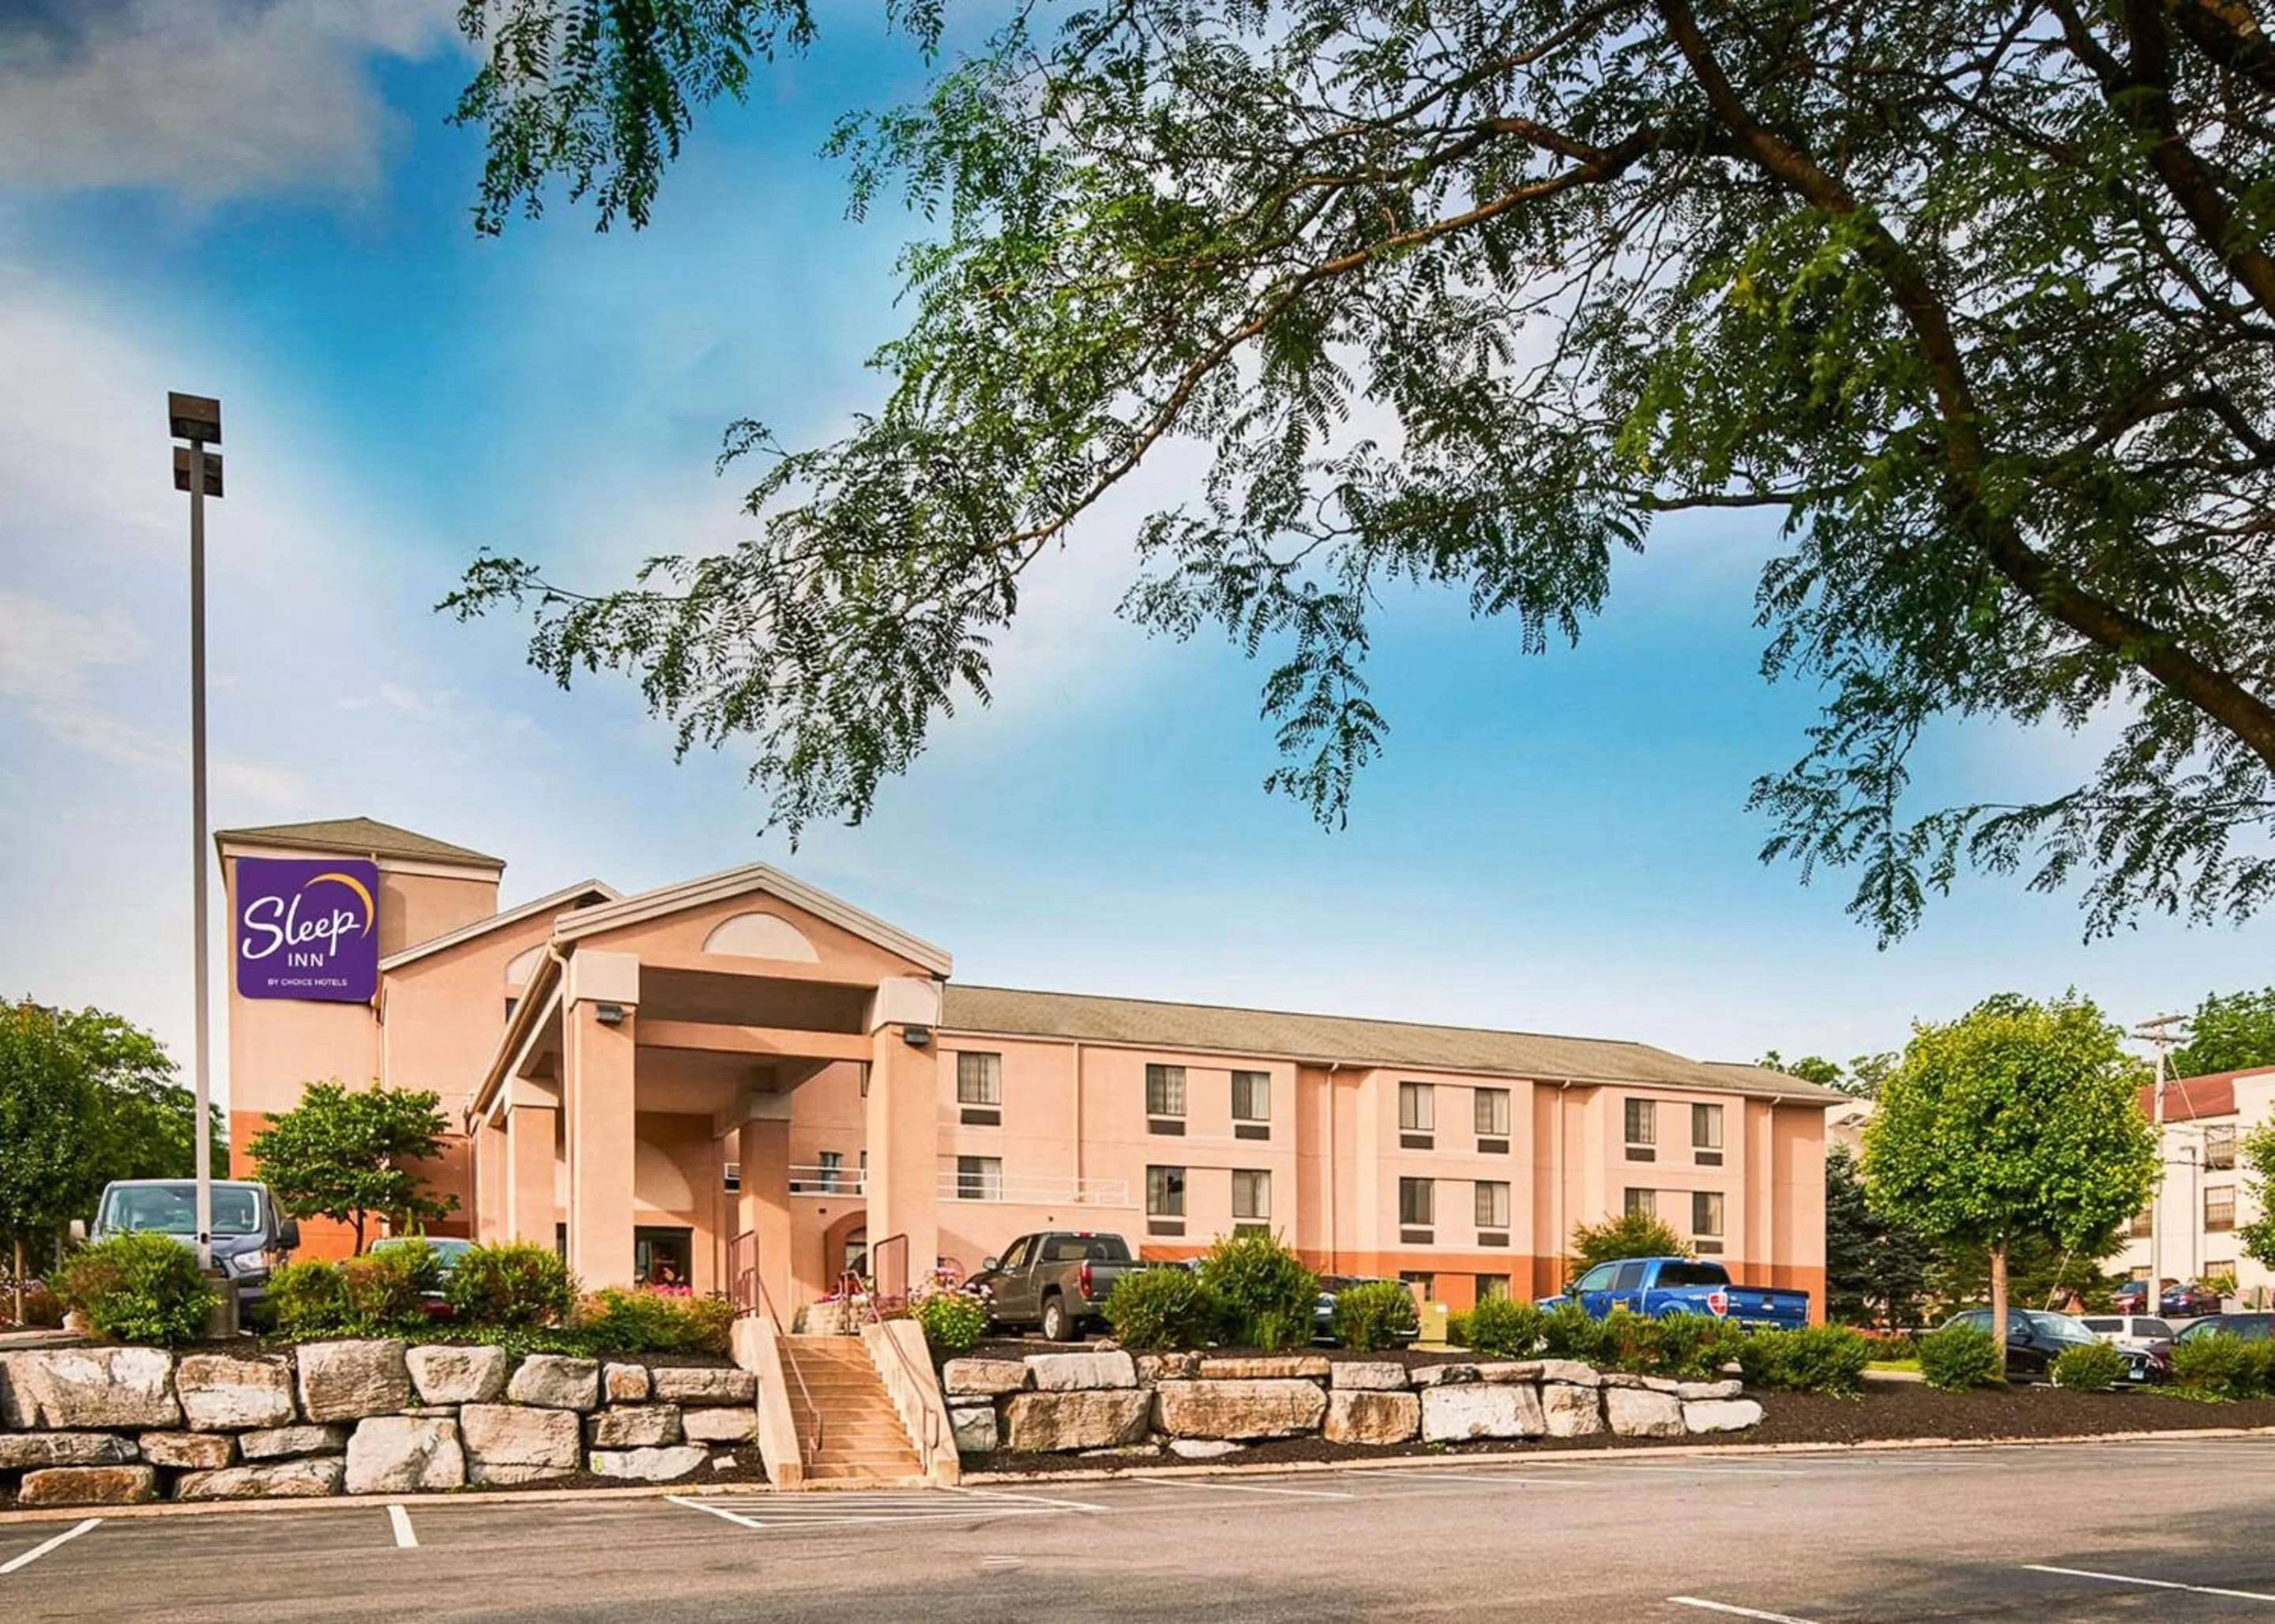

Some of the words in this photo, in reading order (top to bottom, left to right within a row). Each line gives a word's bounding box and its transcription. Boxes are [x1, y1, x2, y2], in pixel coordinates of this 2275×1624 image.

[242, 893, 360, 960] Sleep
[288, 953, 324, 968] INN
[267, 978, 279, 987] BY
[280, 978, 313, 987] CHOICE
[314, 978, 348, 987] HOTELS
